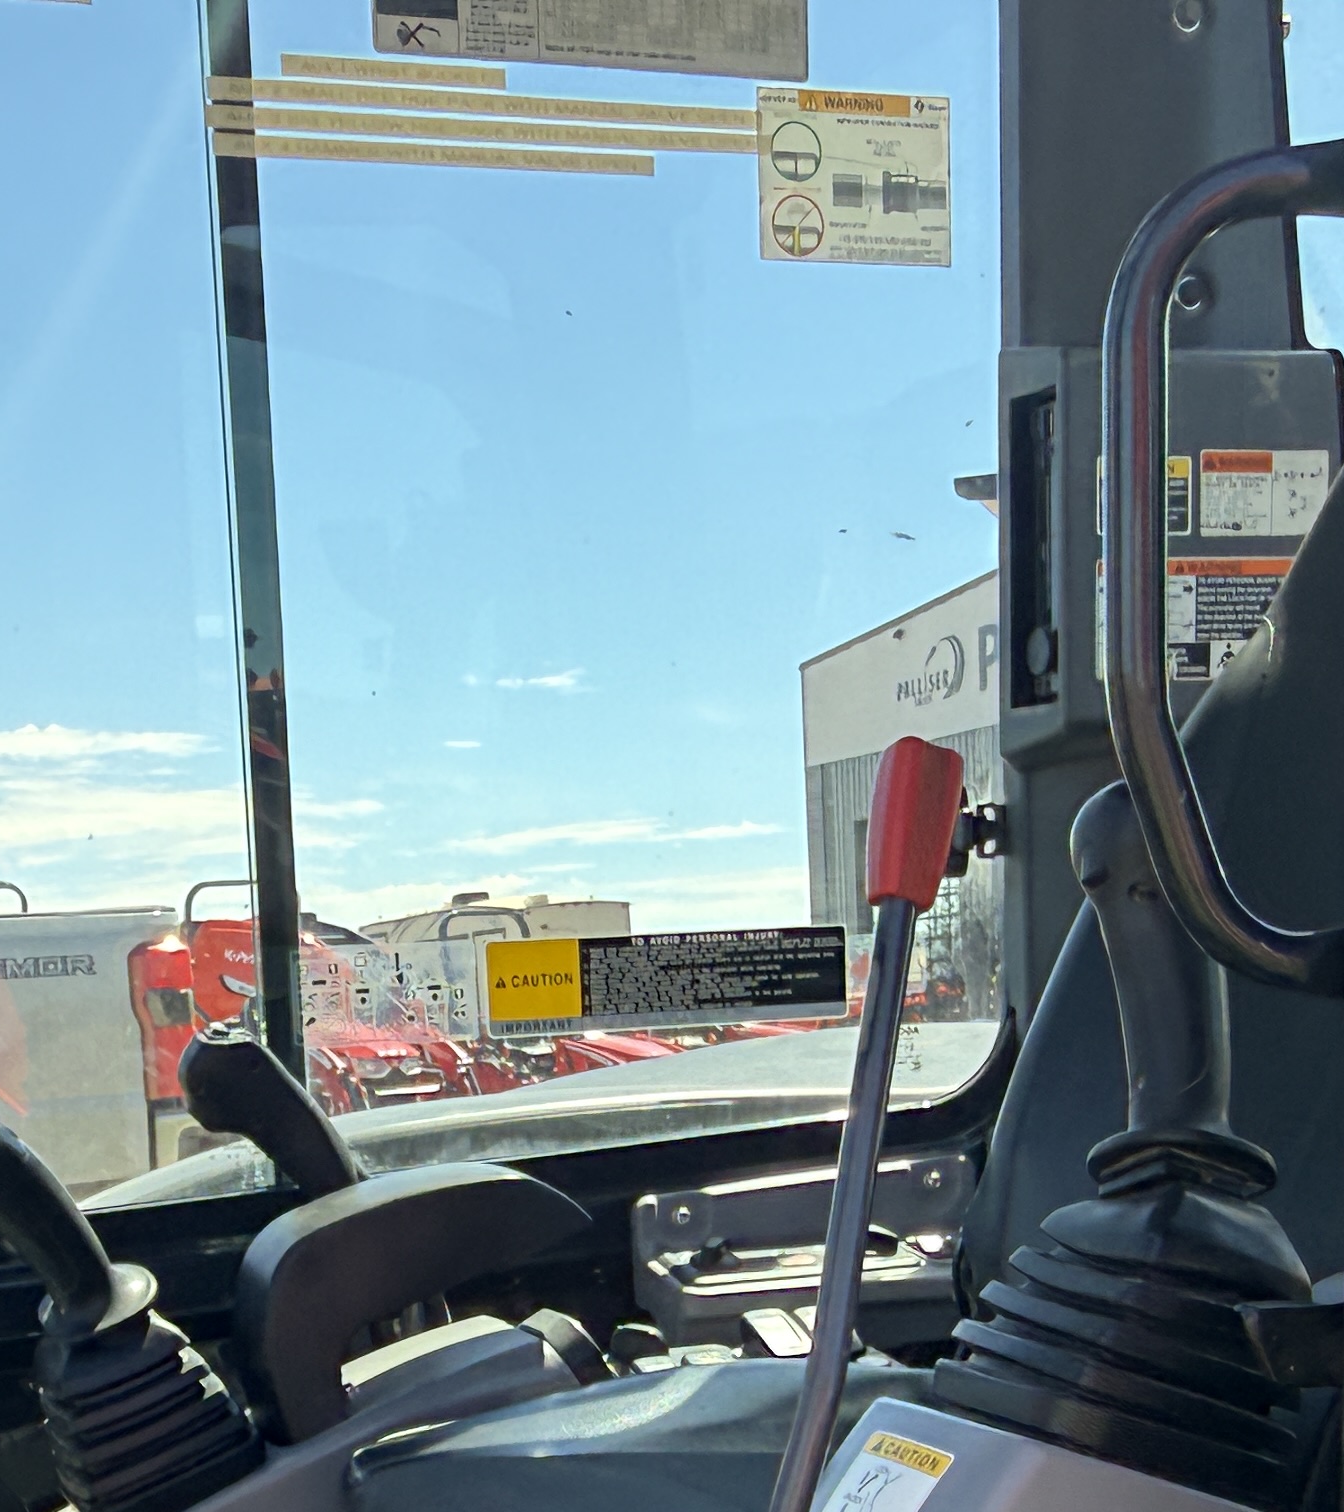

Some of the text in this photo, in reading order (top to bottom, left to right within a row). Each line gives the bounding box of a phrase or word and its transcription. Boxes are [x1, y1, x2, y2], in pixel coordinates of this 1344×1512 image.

[896, 668, 949, 702] PALLISER
[511, 972, 574, 989] CAUTION
[885, 1442, 941, 1472] CAUTION
